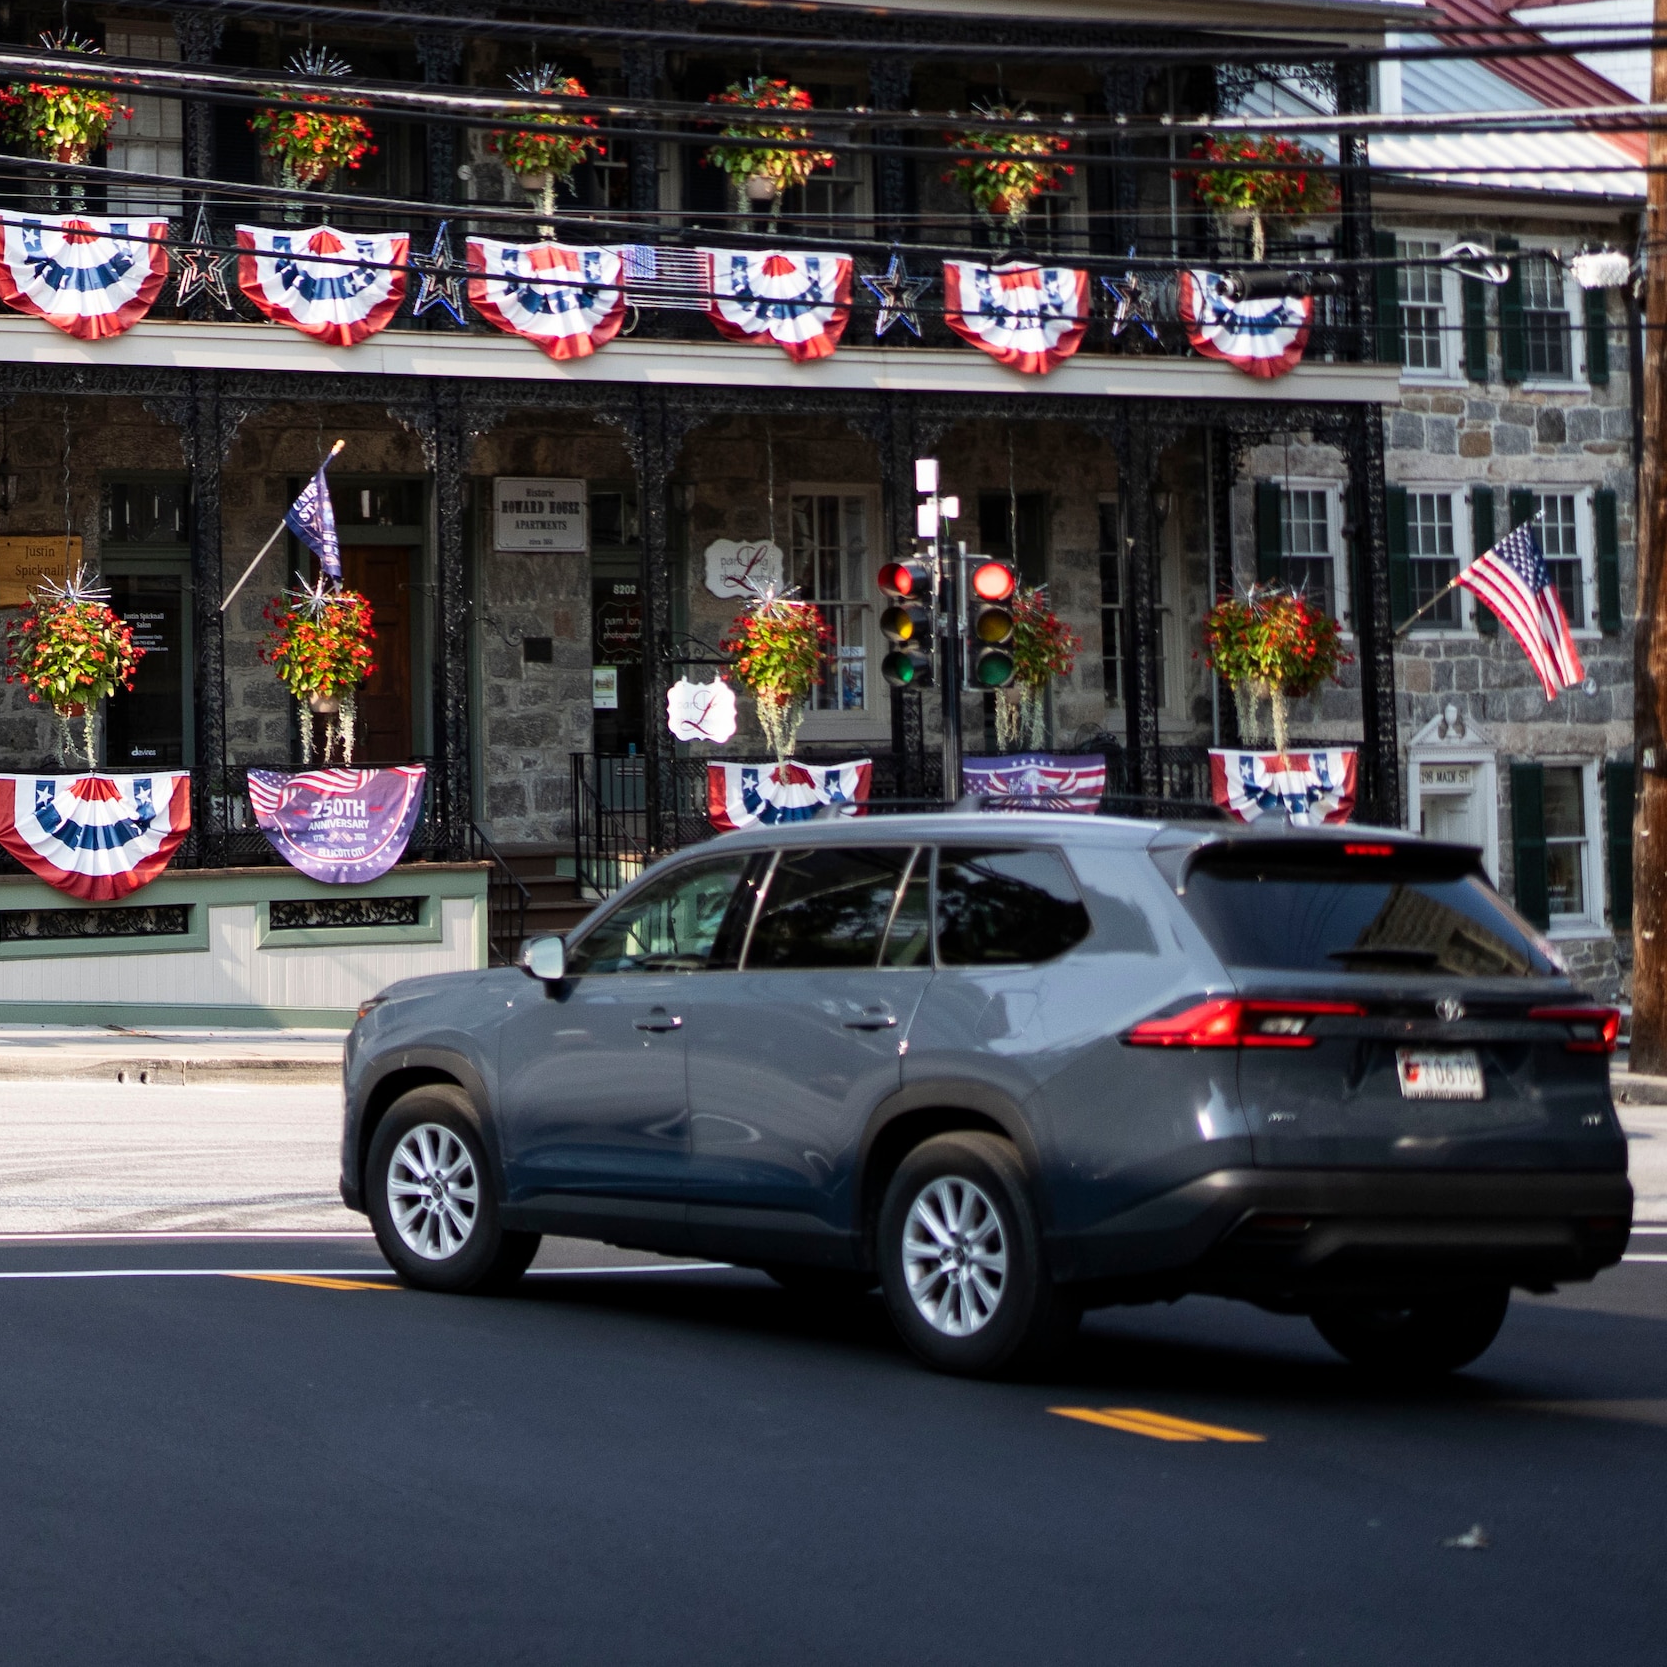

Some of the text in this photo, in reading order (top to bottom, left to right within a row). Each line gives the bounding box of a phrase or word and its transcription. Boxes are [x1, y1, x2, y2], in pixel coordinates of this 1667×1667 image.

[526, 487, 556, 499] Historic
[501, 500, 581, 515] HOWARD HOUSE
[514, 520, 568, 531] APARTMENTS
[25, 545, 56, 559] Justin
[15, 564, 64, 579] Spicknall
[613, 584, 637, 595] 8202
[604, 618, 624, 629] pam
[1436, 770, 1456, 784] MAIN
[311, 798, 366, 819] 250TH
[308, 818, 370, 832] ANNIVERSARY
[313, 834, 325, 843] 1776
[317, 845, 366, 859] ELLICOTT CITY
